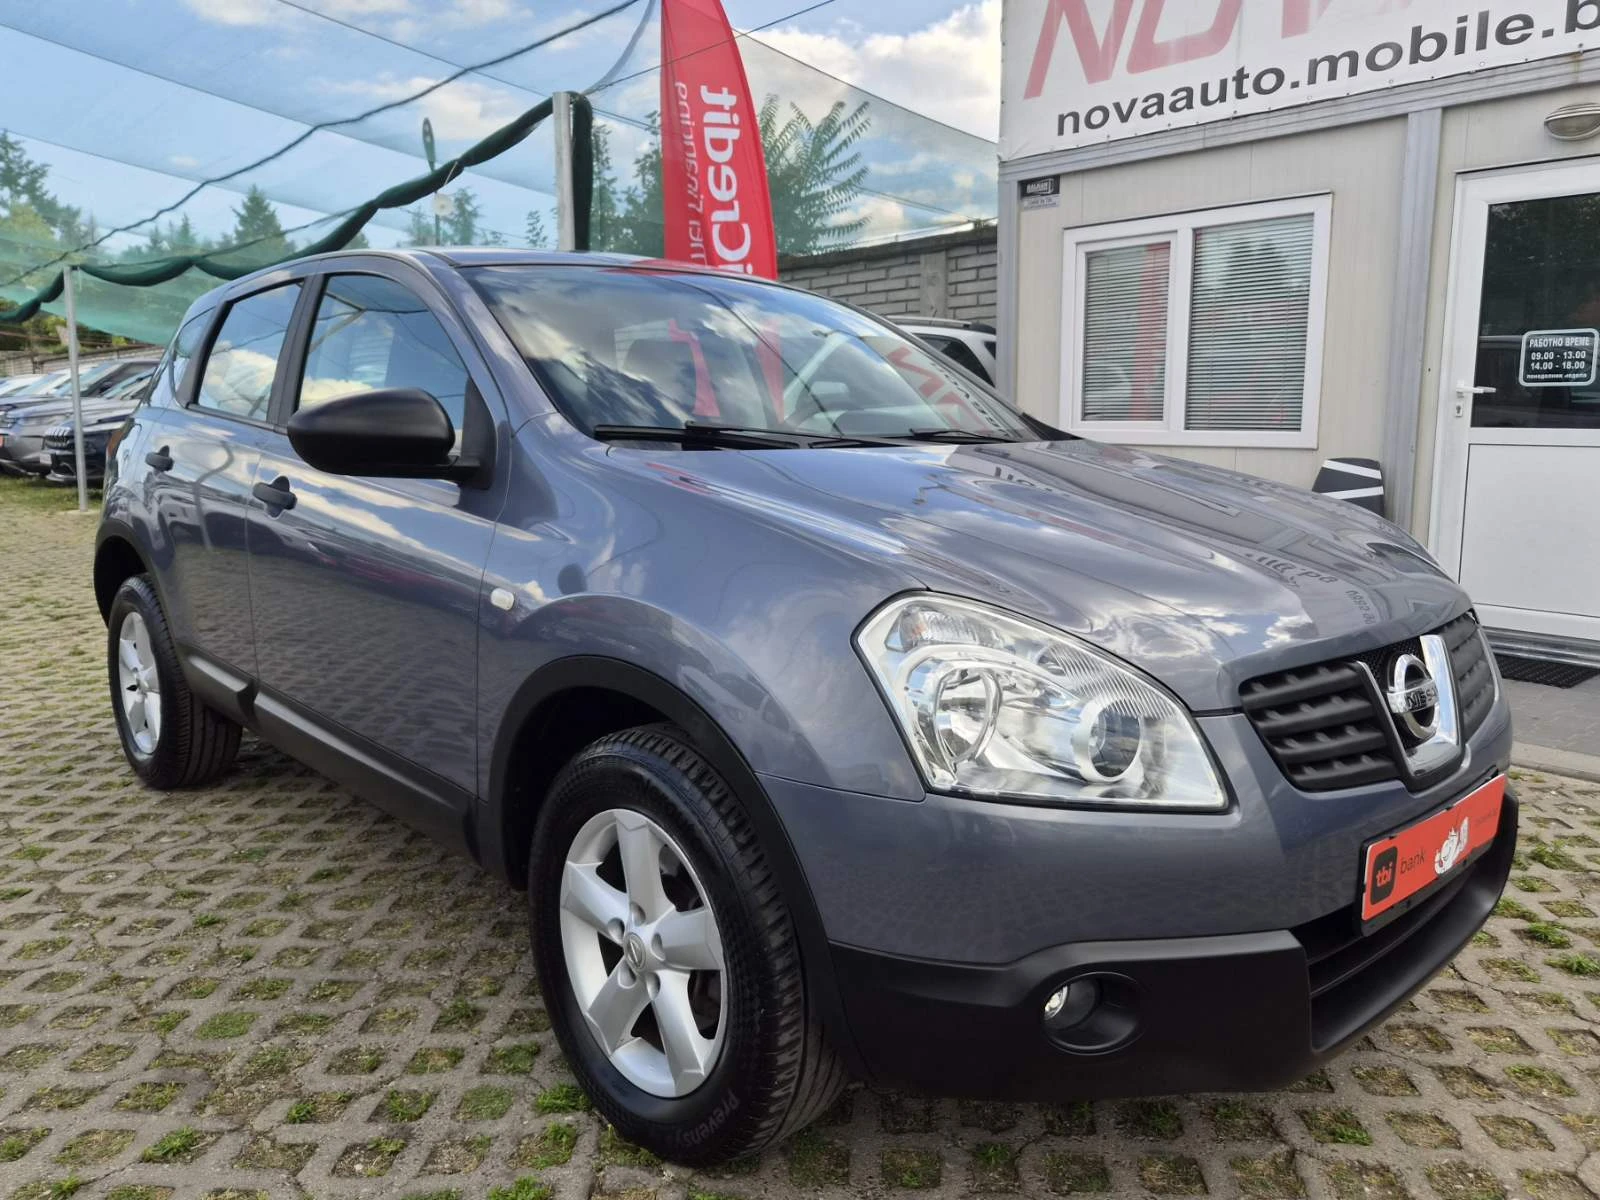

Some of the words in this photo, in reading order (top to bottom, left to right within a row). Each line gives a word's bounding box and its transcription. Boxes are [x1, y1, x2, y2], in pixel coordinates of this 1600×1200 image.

[1529, 338, 1564, 348] РАБОТНО
[1564, 336, 1590, 347] ВРЕМЕ
[1531, 351, 1554, 360] 09.00
[1562, 350, 1586, 359] 13.00
[1530, 361, 1553, 370] 14.00
[1562, 361, 1585, 370] 18.00
[1375, 861, 1393, 888] tbi
[1400, 848, 1426, 875] bank
